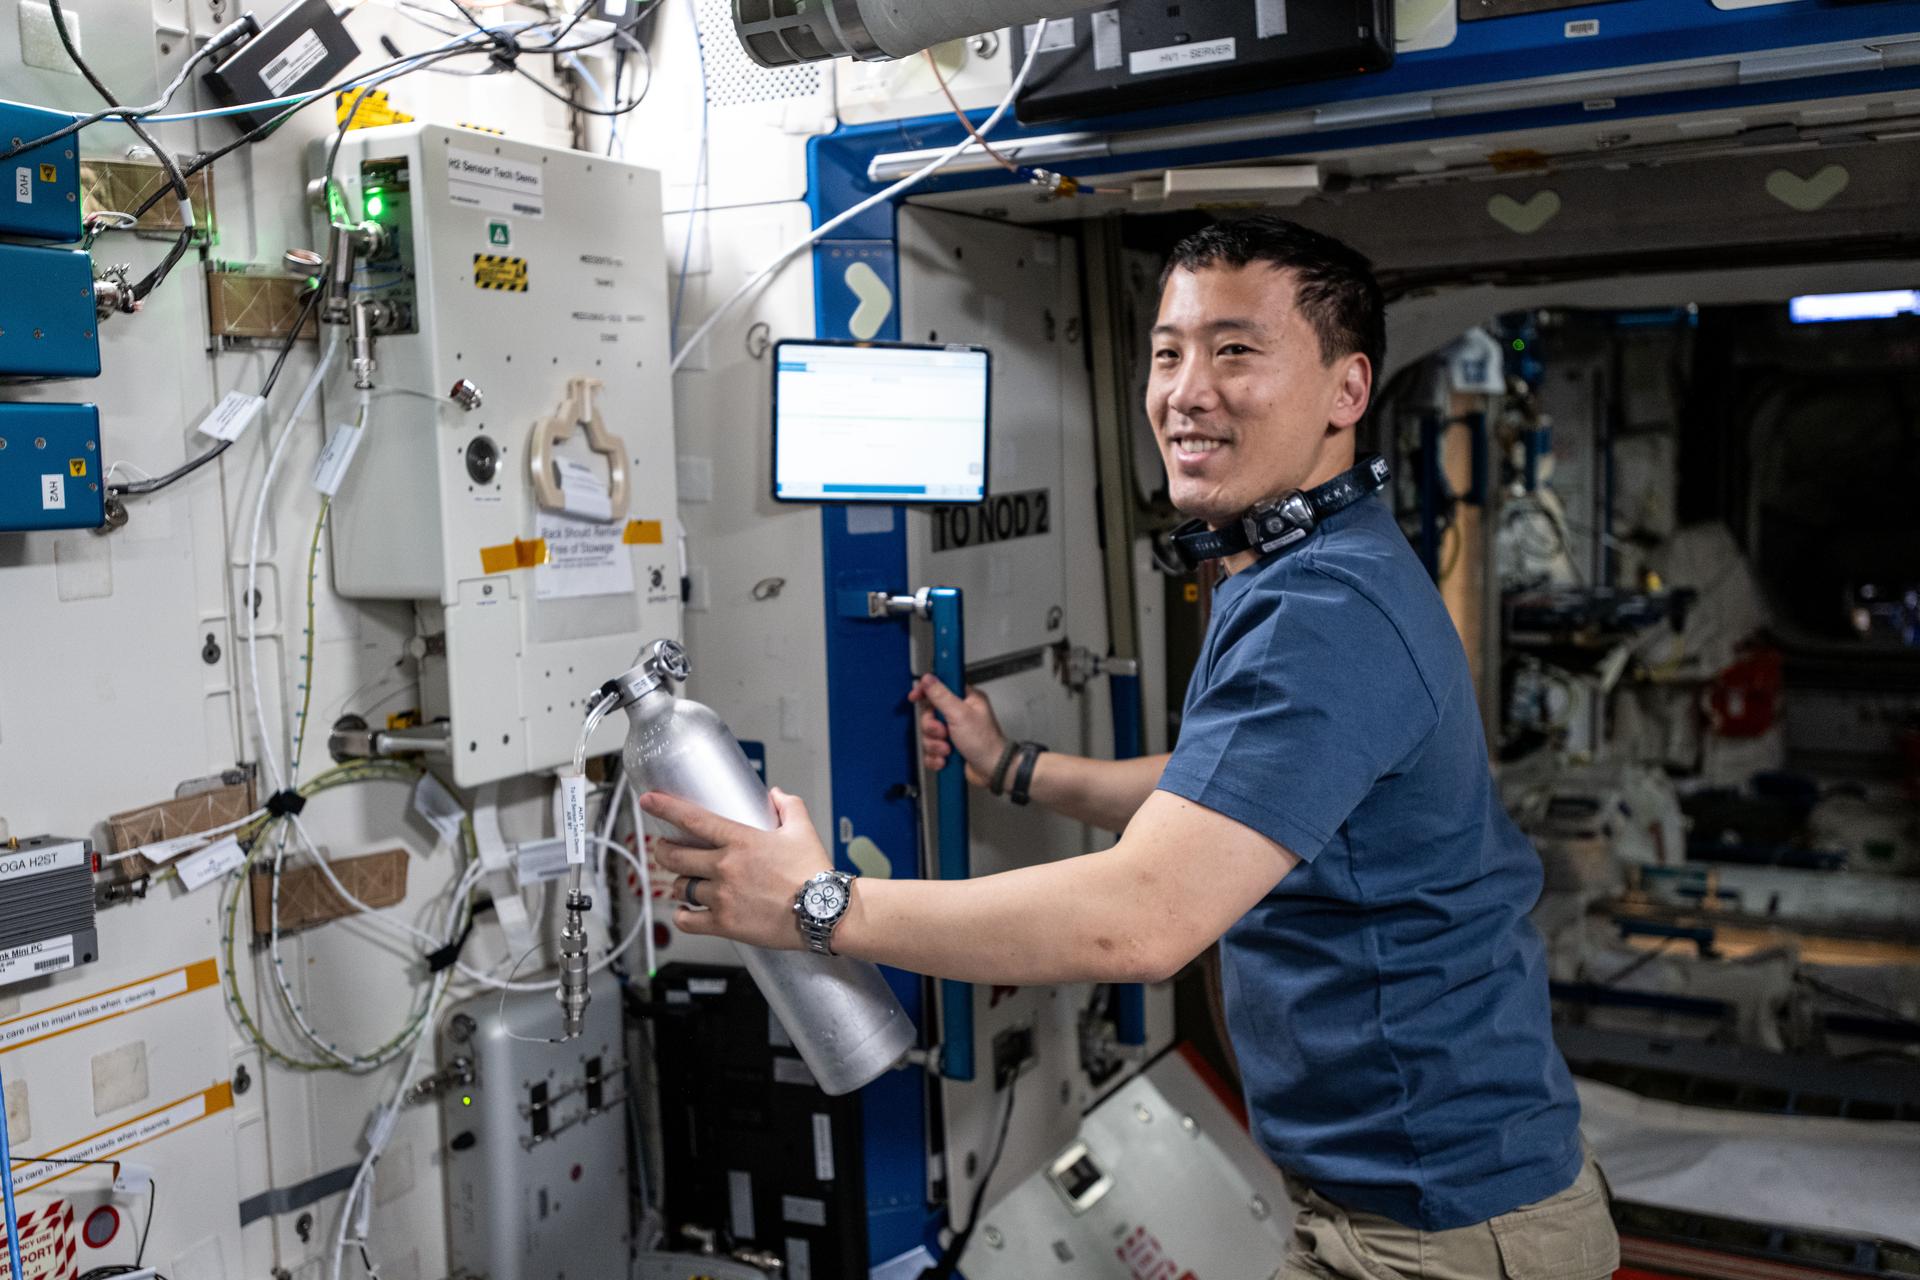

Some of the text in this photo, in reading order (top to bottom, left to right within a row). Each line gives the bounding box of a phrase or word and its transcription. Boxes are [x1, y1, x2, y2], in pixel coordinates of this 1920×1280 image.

[463, 160, 491, 176] Sensor
[494, 166, 512, 179] Tech
[20, 174, 29, 196] HV3
[49, 480, 59, 502] HV2
[565, 526, 591, 538] Should
[932, 493, 1049, 552] TO NOD 2
[581, 542, 614, 555] Stowage
[29, 852, 58, 868] H2ST
[11, 946, 29, 958] Mini
[31, 943, 43, 954] PC
[6, 1028, 25, 1040] care
[26, 1021, 40, 1033] not
[41, 1018, 50, 1028] to
[51, 1011, 77, 1028] impart
[78, 1004, 99, 1018] loads
[100, 998, 121, 1011] when
[125, 987, 156, 1004] cleaning
[25, 1168, 43, 1181] care
[45, 1164, 53, 1173] to
[68, 1147, 94, 1163] impart
[95, 1138, 115, 1152] loads
[117, 1127, 137, 1142] when
[140, 1116, 170, 1136] cleaning
[21, 1243, 52, 1266] PORT
